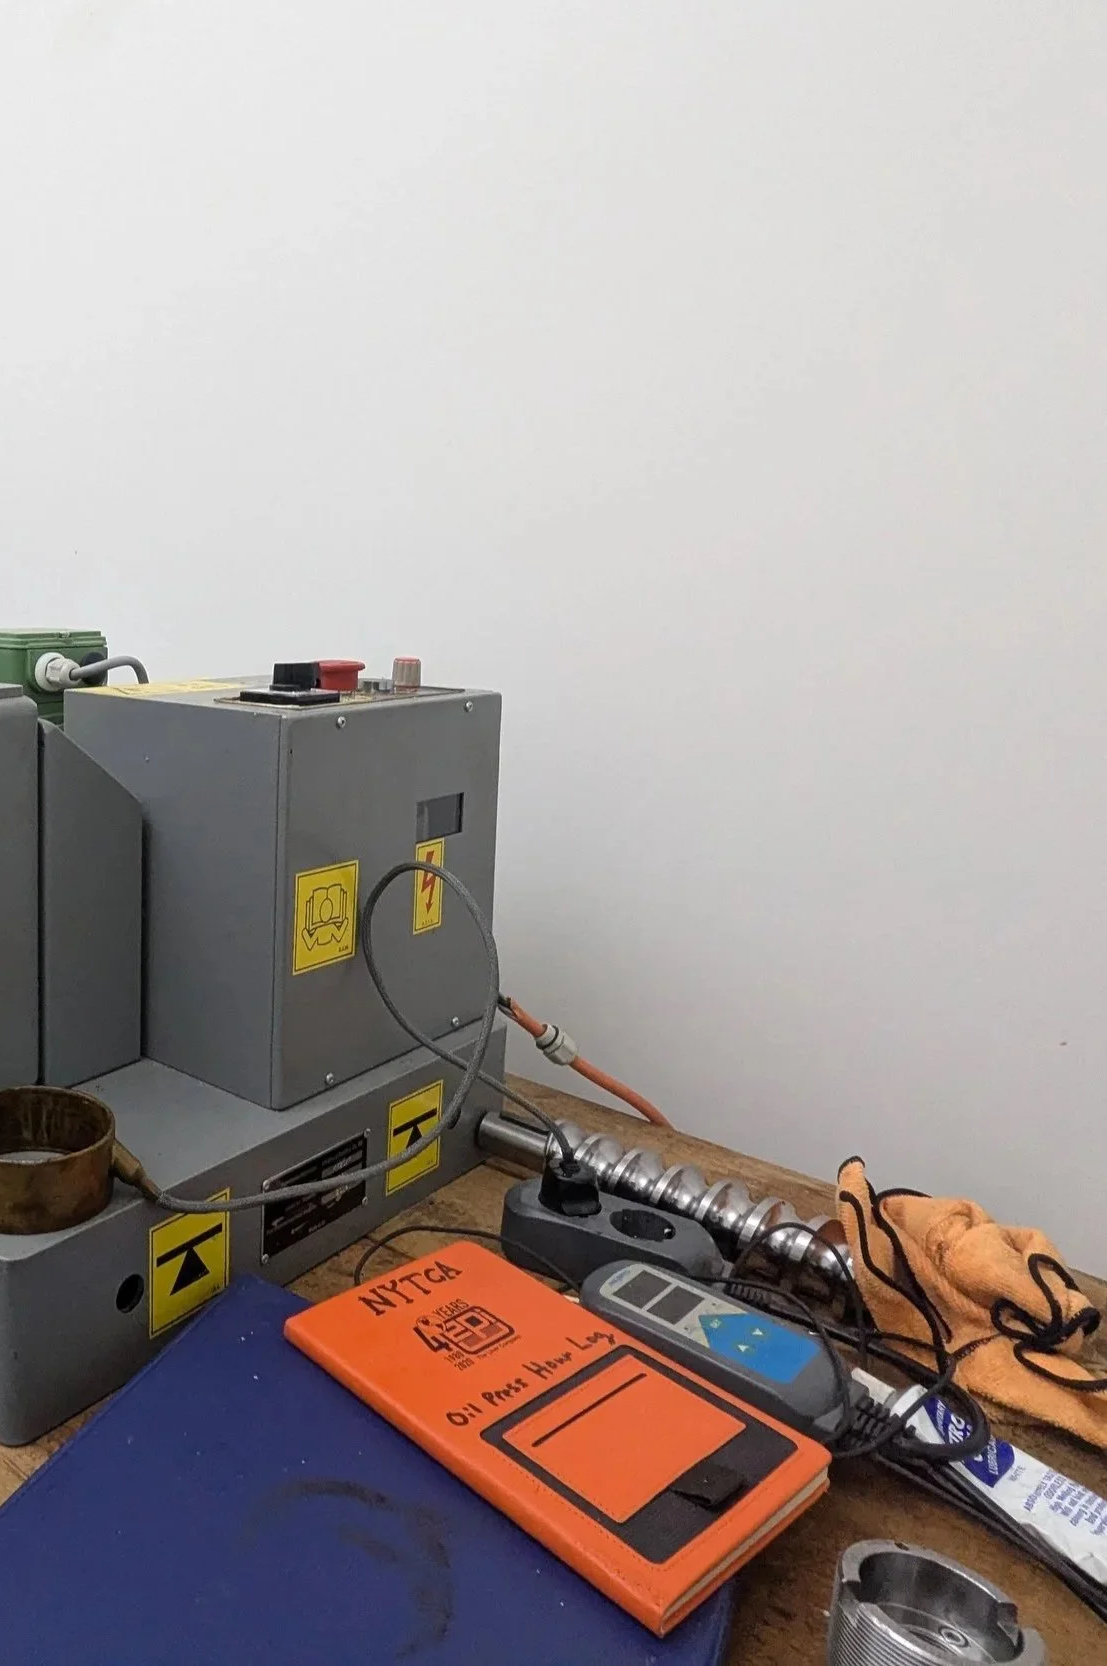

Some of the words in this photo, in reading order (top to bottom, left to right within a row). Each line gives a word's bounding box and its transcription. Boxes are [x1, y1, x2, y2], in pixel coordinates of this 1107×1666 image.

[358, 1261, 463, 1316] NYTCA
[433, 1299, 470, 1321] YEARS
[446, 1402, 483, 1426] Oil
[481, 1377, 529, 1407] Press
[522, 1351, 573, 1380] Hour
